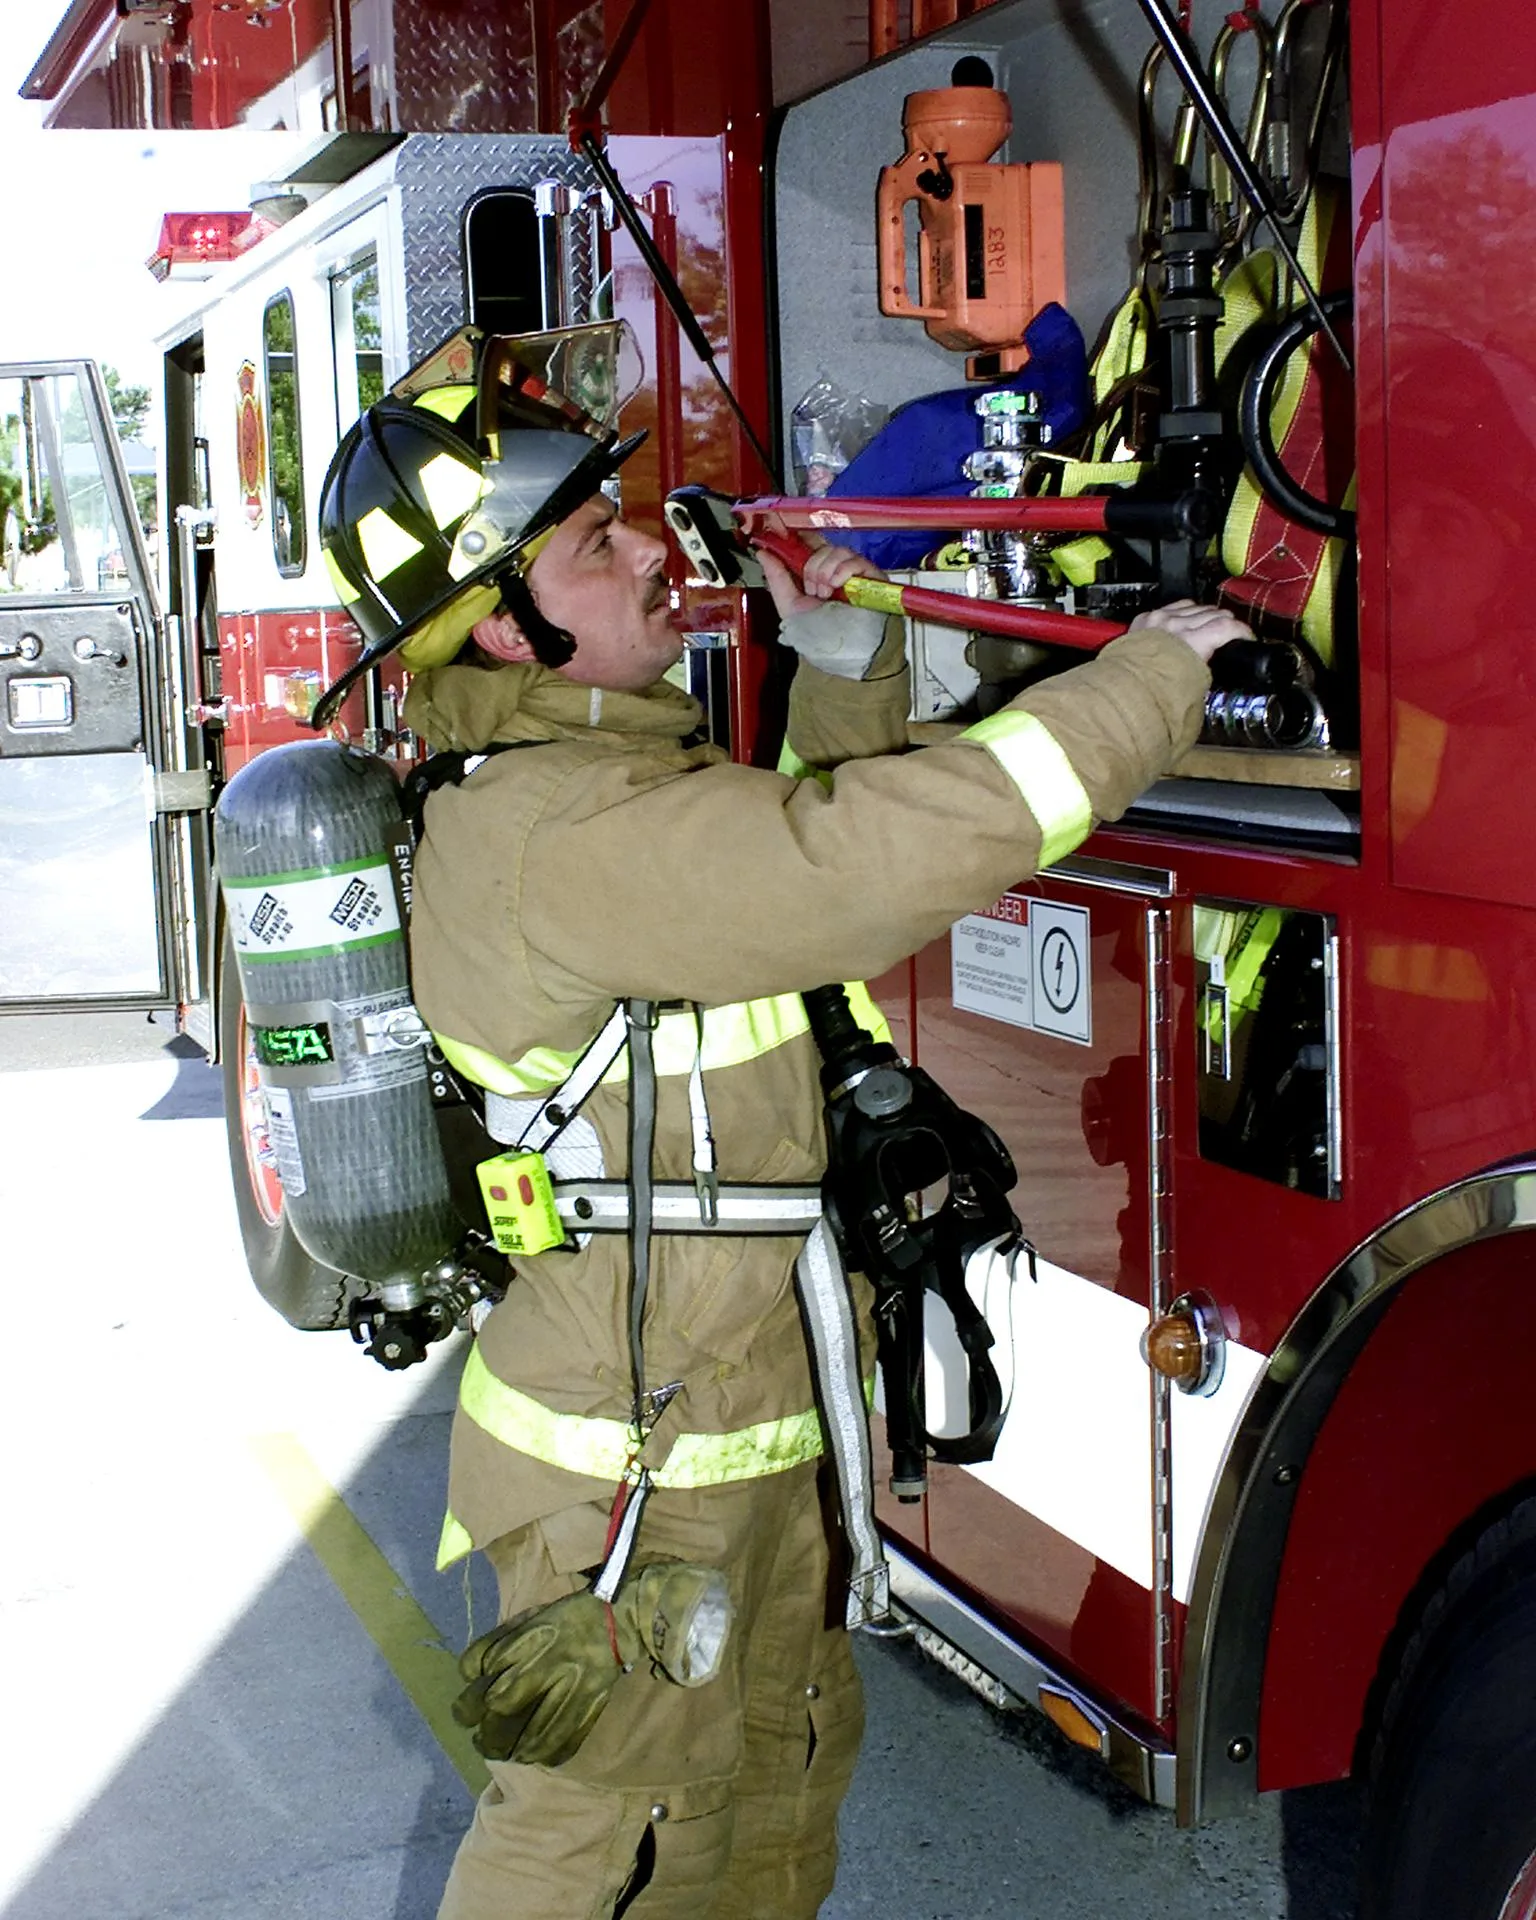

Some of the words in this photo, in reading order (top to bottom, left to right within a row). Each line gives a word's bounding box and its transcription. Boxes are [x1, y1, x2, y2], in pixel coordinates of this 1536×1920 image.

[987, 227, 1006, 276] 1283
[251, 893, 278, 936] MSA
[330, 878, 367, 925] MSA
[347, 891, 378, 931] Stealth
[262, 907, 288, 945] Stealth
[265, 1029, 329, 1062] SA
